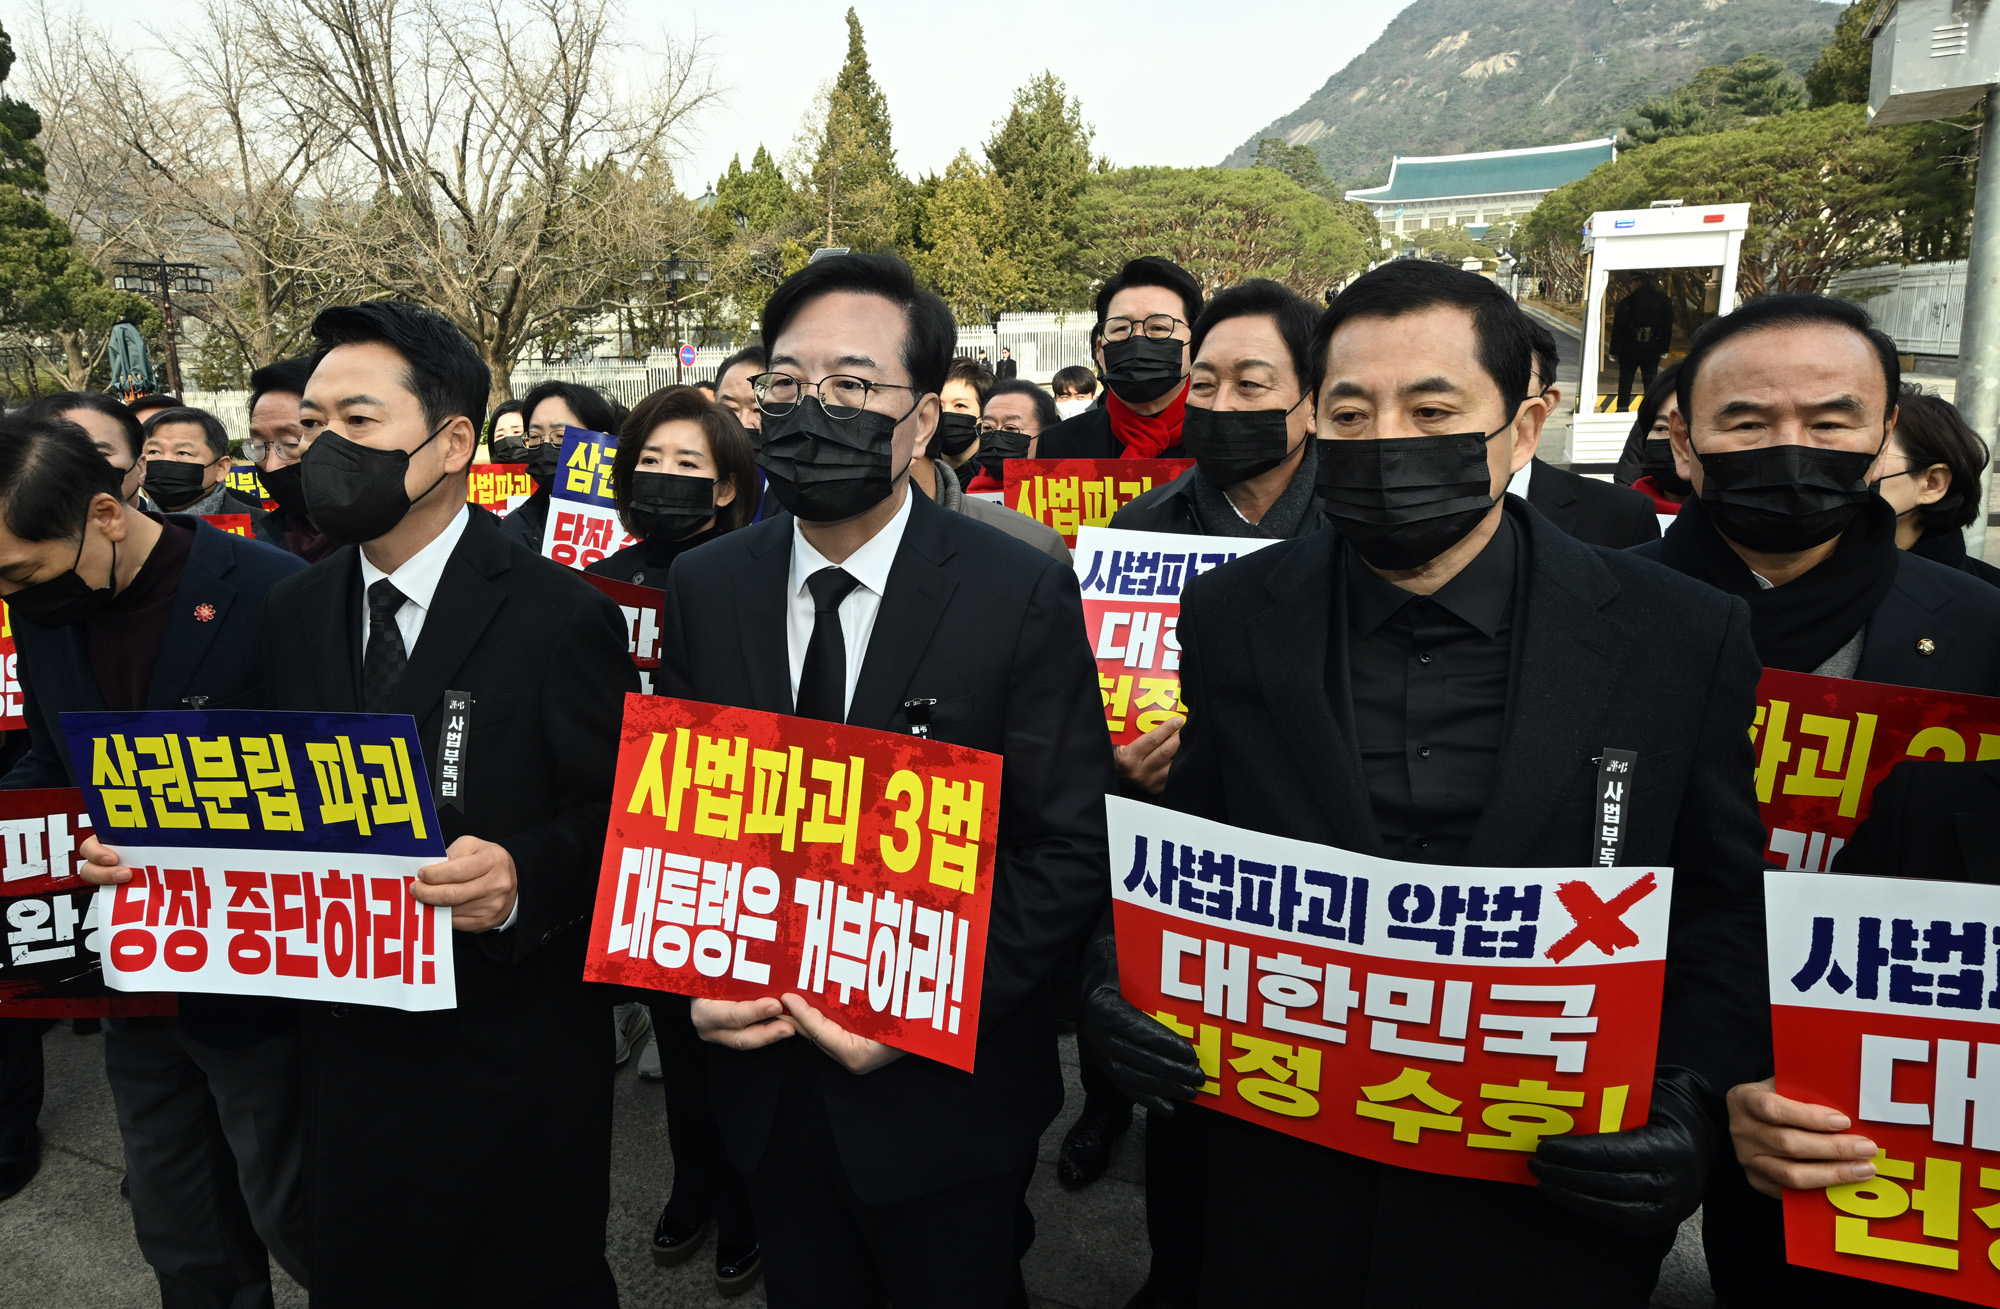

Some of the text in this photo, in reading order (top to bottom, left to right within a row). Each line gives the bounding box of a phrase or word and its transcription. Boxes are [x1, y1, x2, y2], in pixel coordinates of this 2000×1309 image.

[92, 733, 427, 839] 삼권분립 파괴
[442, 715, 464, 797] 사법부독립
[627, 727, 984, 894] 사법파괴 3법
[110, 865, 436, 985] 당장 중단하라!
[607, 846, 969, 1035] 대통령은 거부하라!
[1123, 834, 1543, 959] 사법파괴 악법
[1160, 928, 1598, 1073] 대한민국
[1791, 916, 2000, 1010] 사법
